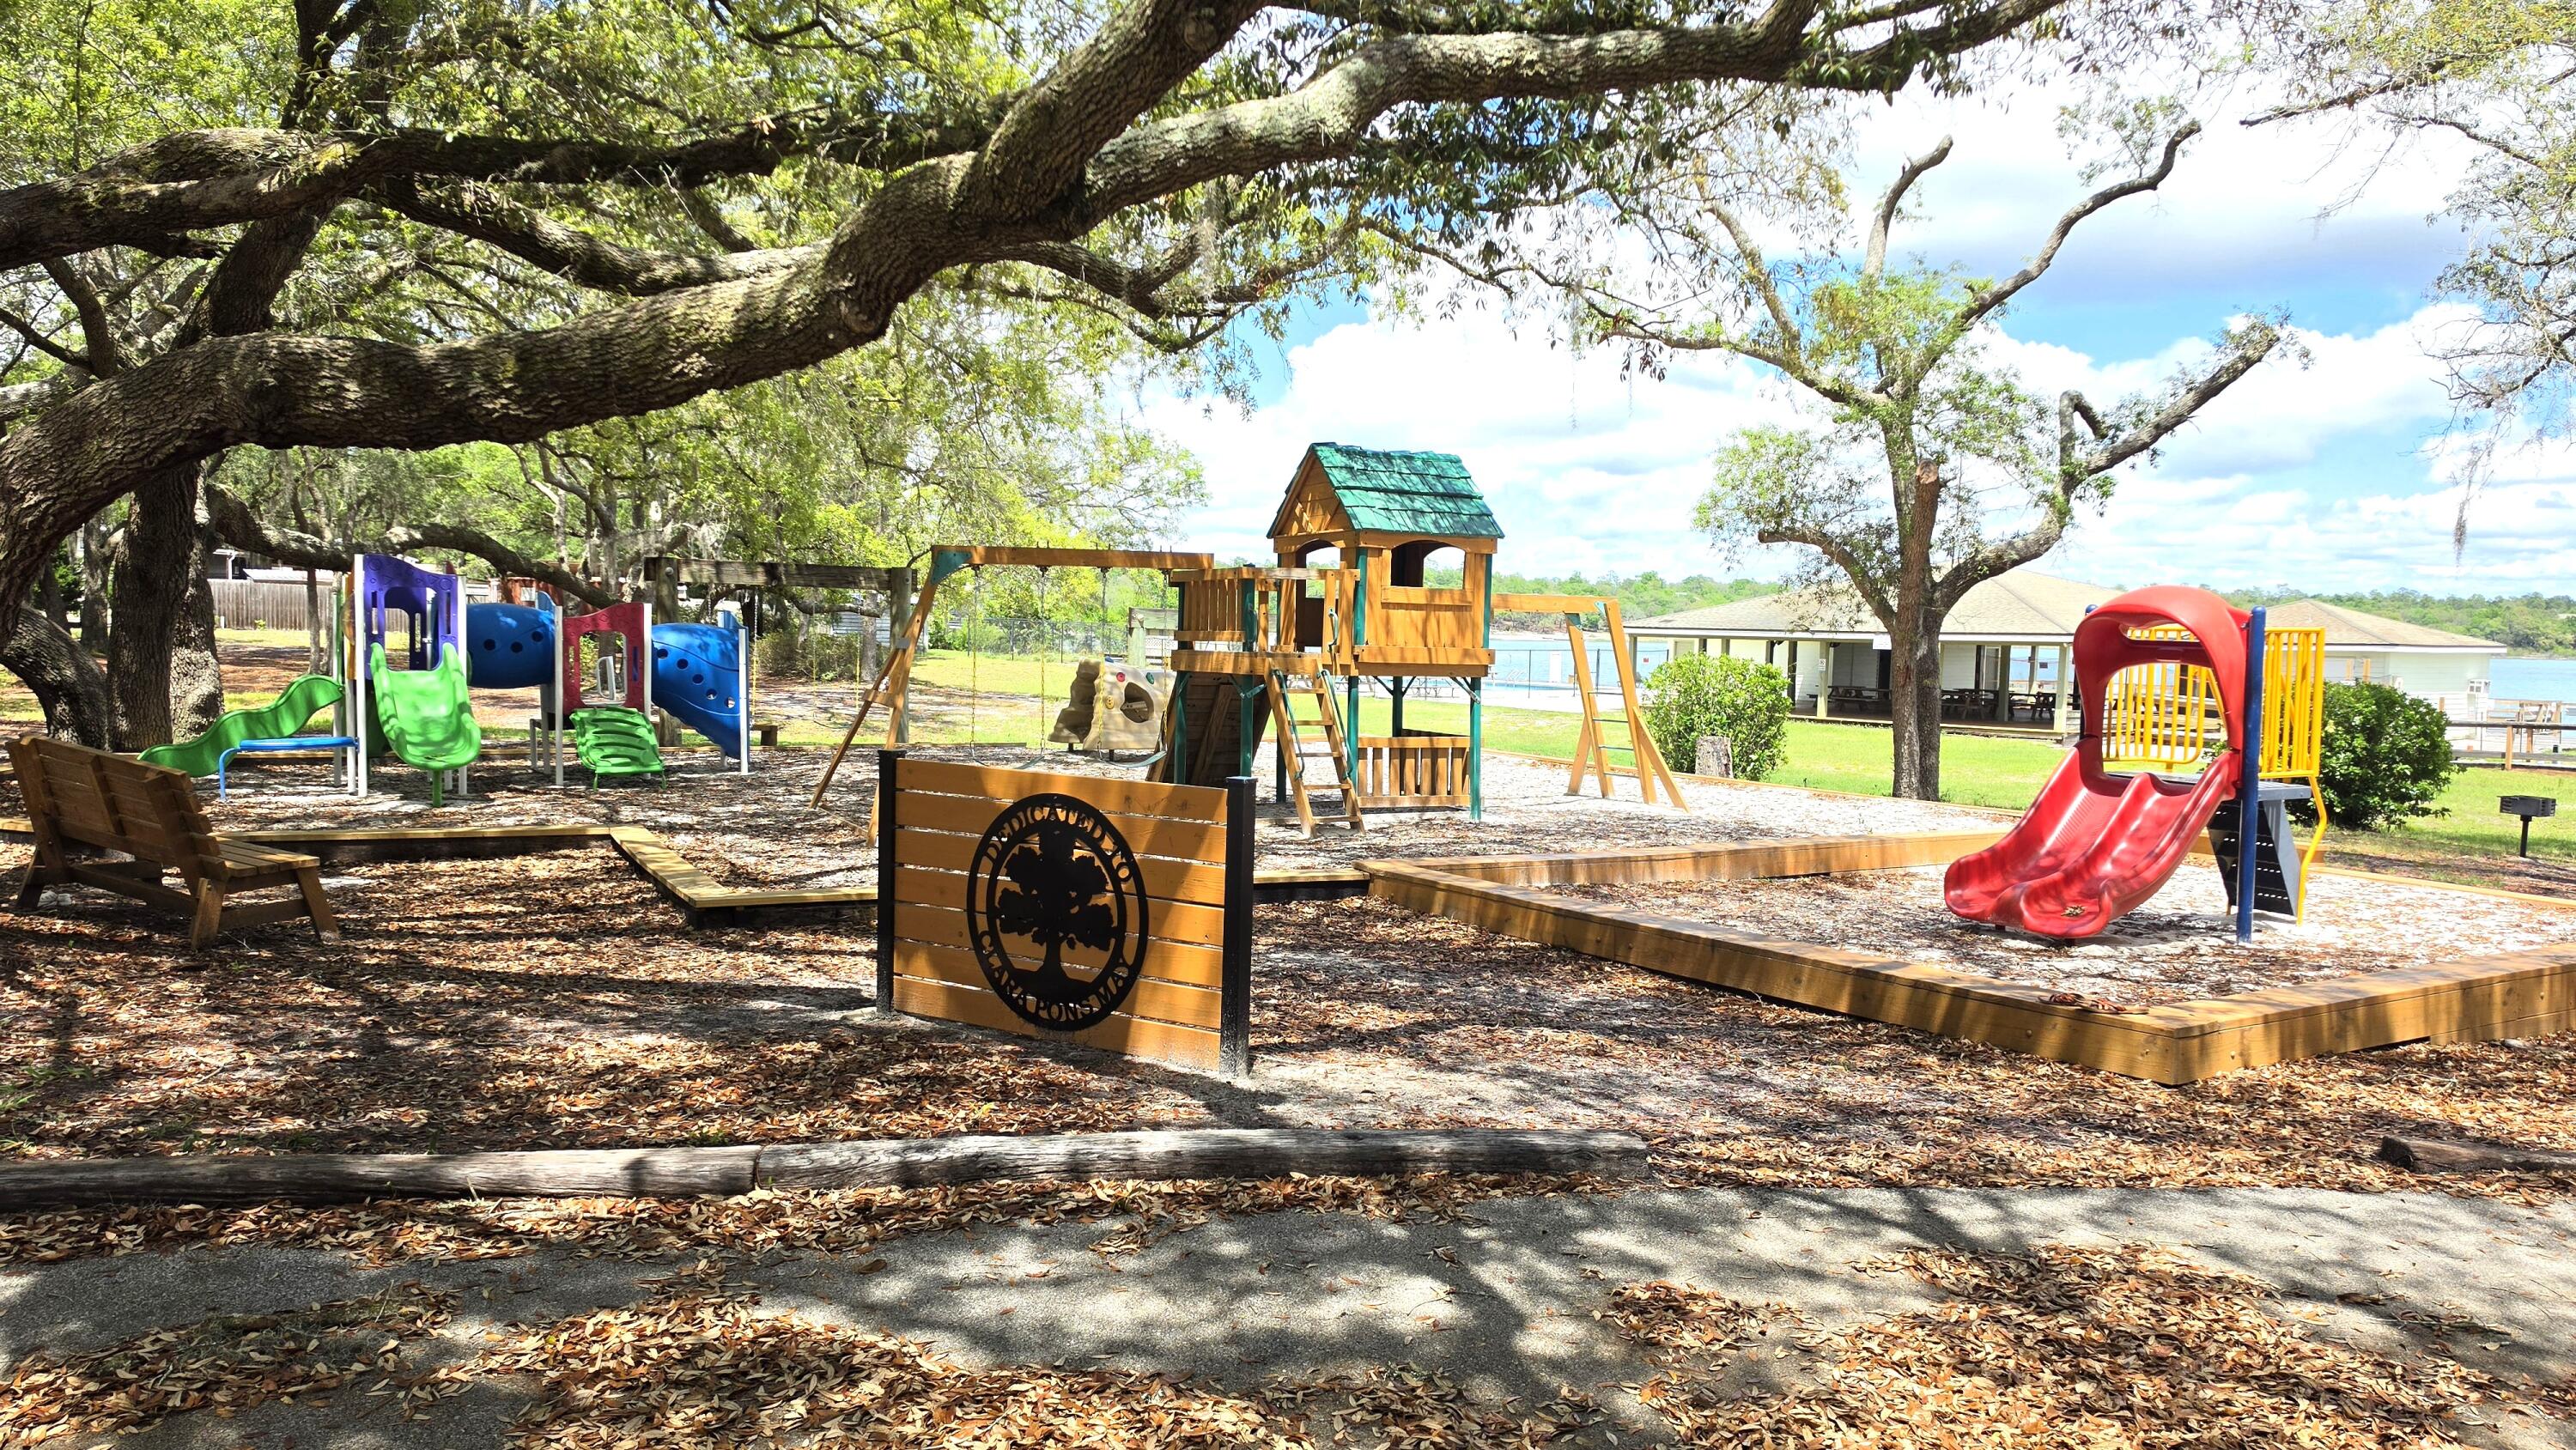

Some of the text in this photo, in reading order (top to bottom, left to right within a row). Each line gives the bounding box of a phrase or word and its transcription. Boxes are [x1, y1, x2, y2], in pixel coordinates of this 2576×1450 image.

[984, 805, 1133, 883] DEDICATED TO
[978, 931, 1028, 1011] CLARA
